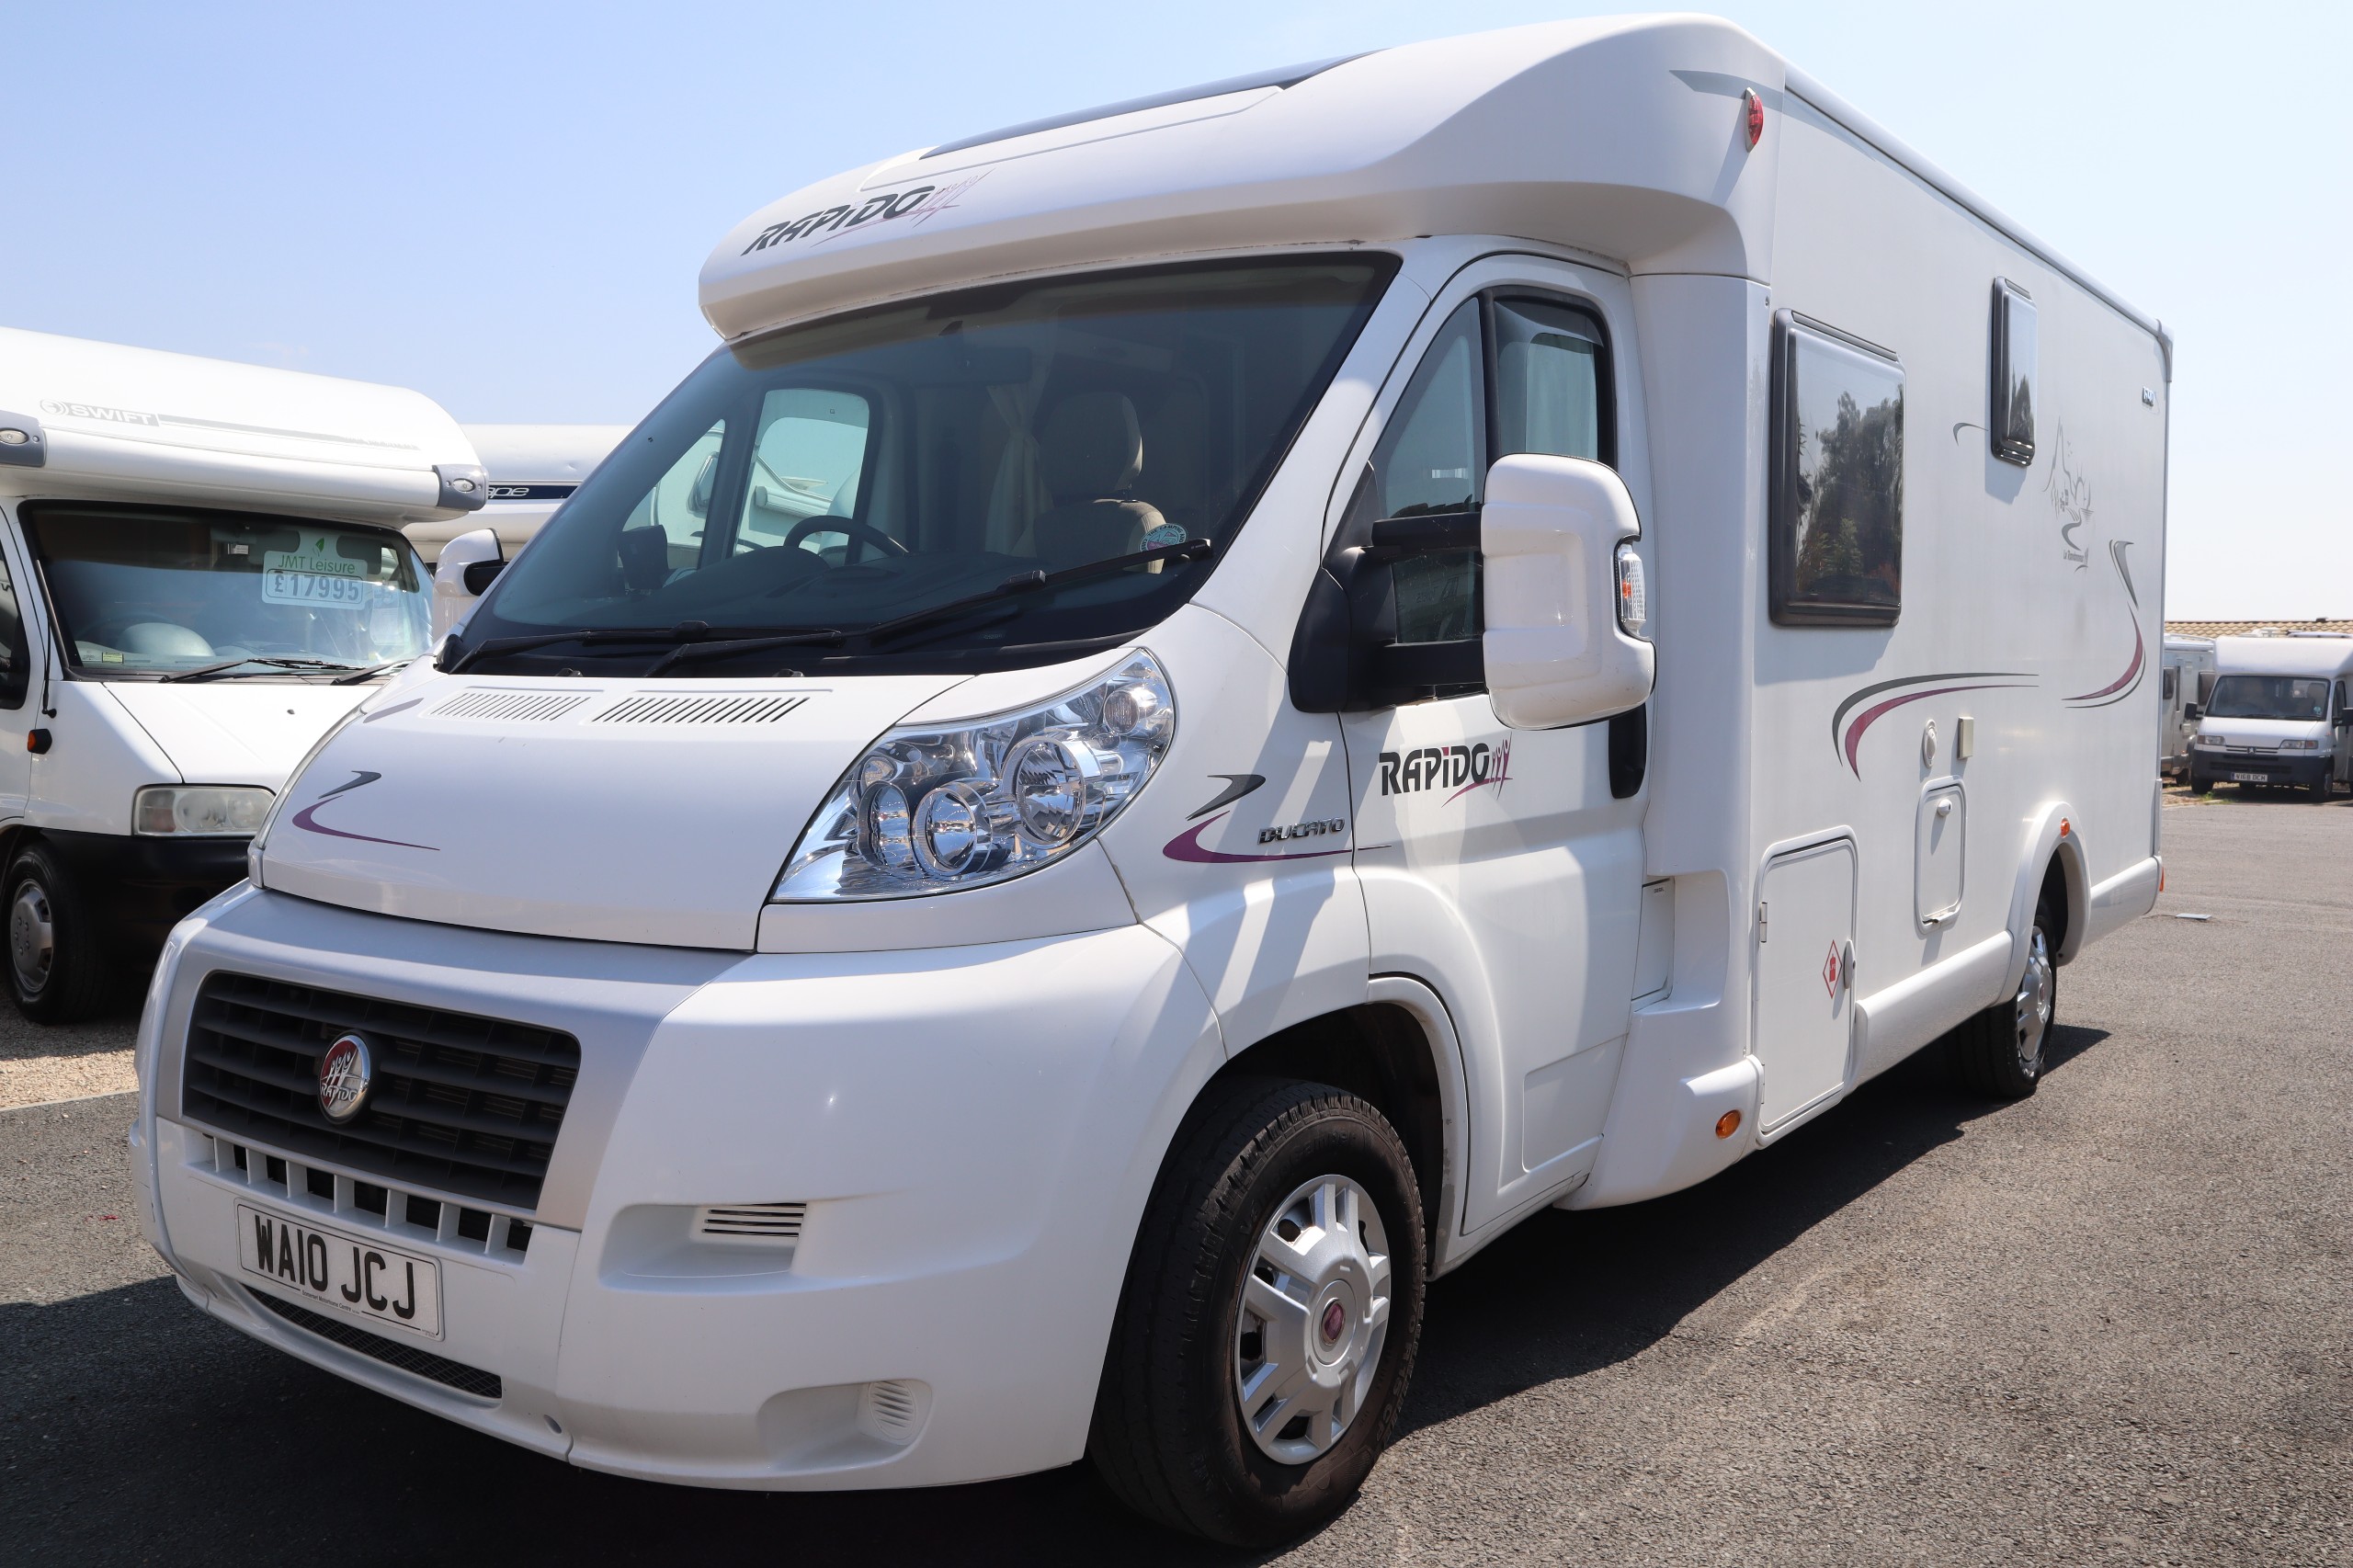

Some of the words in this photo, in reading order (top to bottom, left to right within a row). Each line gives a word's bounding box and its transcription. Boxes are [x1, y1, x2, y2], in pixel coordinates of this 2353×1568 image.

[70, 404, 152, 426] SWIFT
[278, 555, 308, 569] JMT
[310, 558, 356, 574] Leisure
[1257, 817, 1345, 845] DUCATO
[255, 1214, 328, 1291] WA10
[341, 1246, 415, 1320] JCJ
